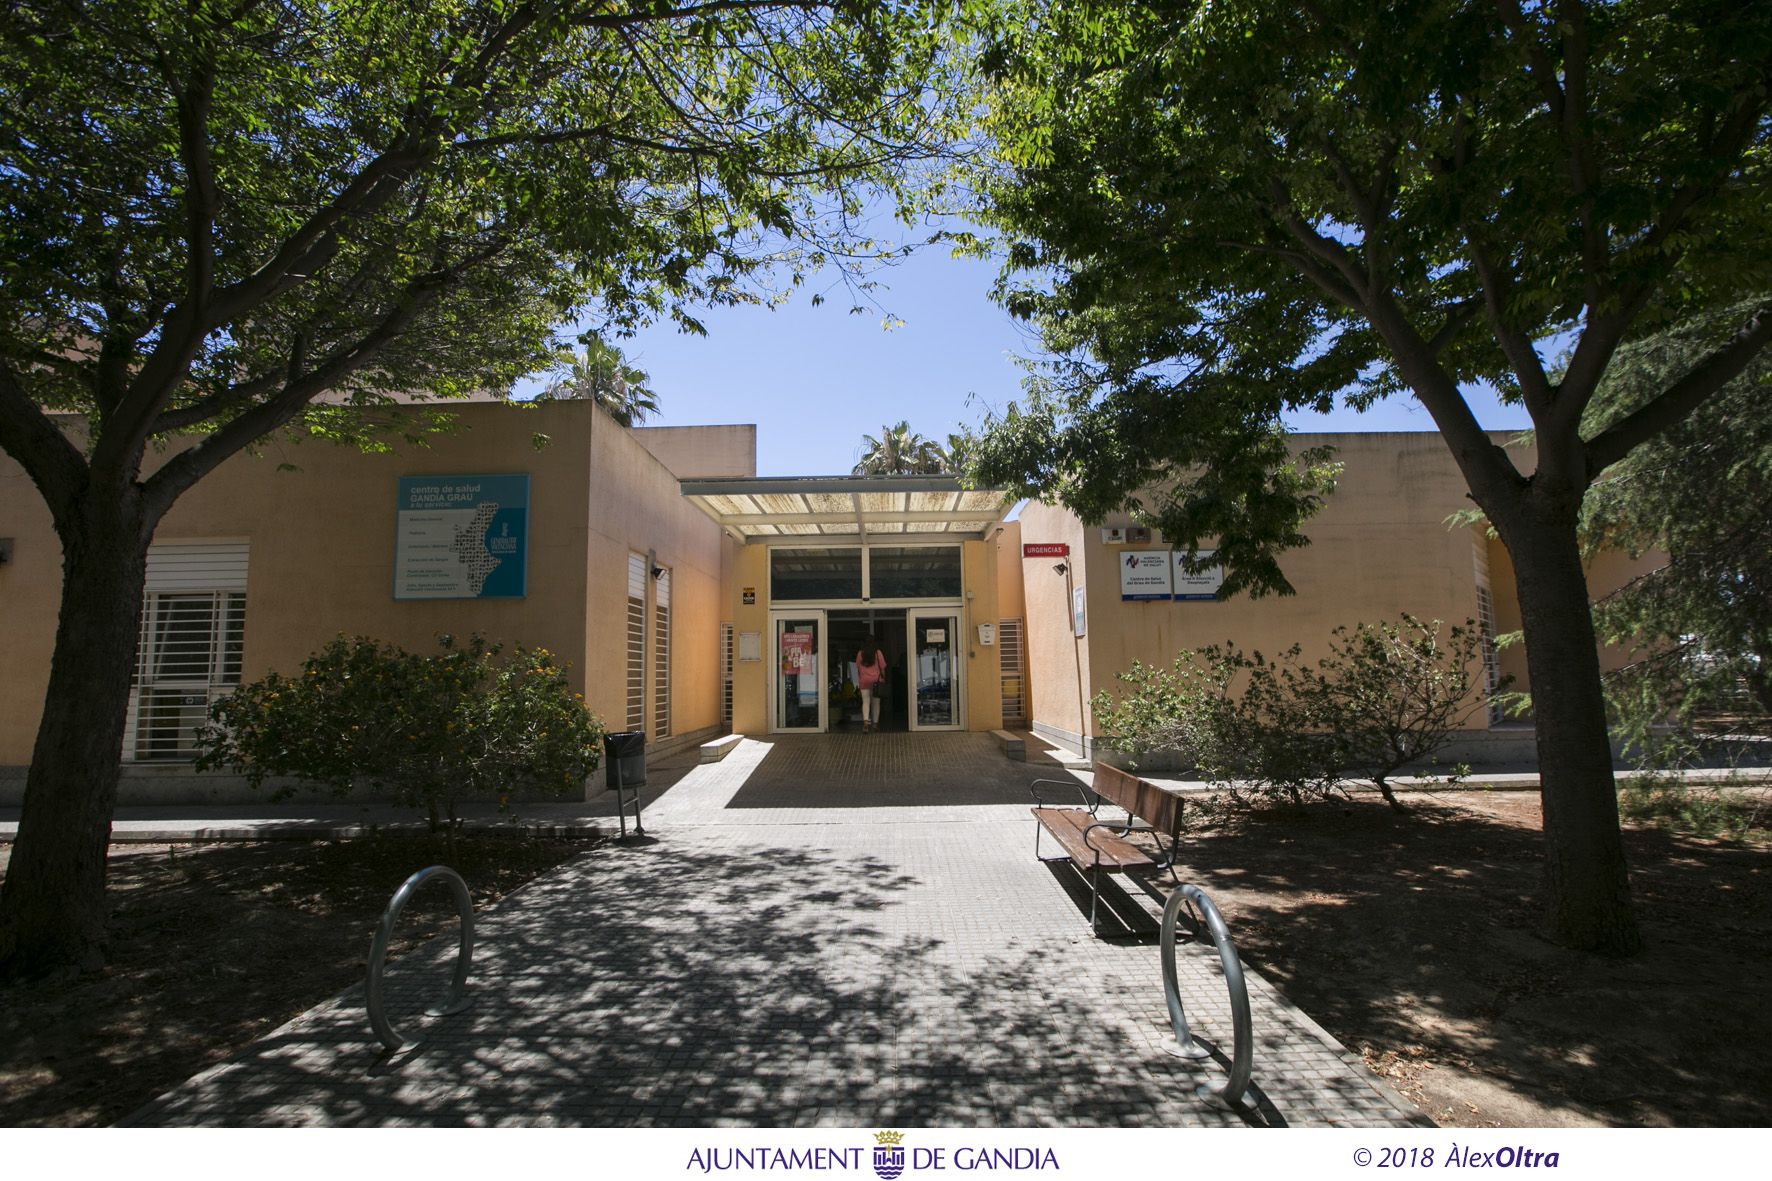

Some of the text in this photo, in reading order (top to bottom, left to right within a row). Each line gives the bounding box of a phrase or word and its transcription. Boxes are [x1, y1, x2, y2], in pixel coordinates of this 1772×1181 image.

[410, 484, 481, 494] centro de salud
[447, 493, 473, 502] GRAU
